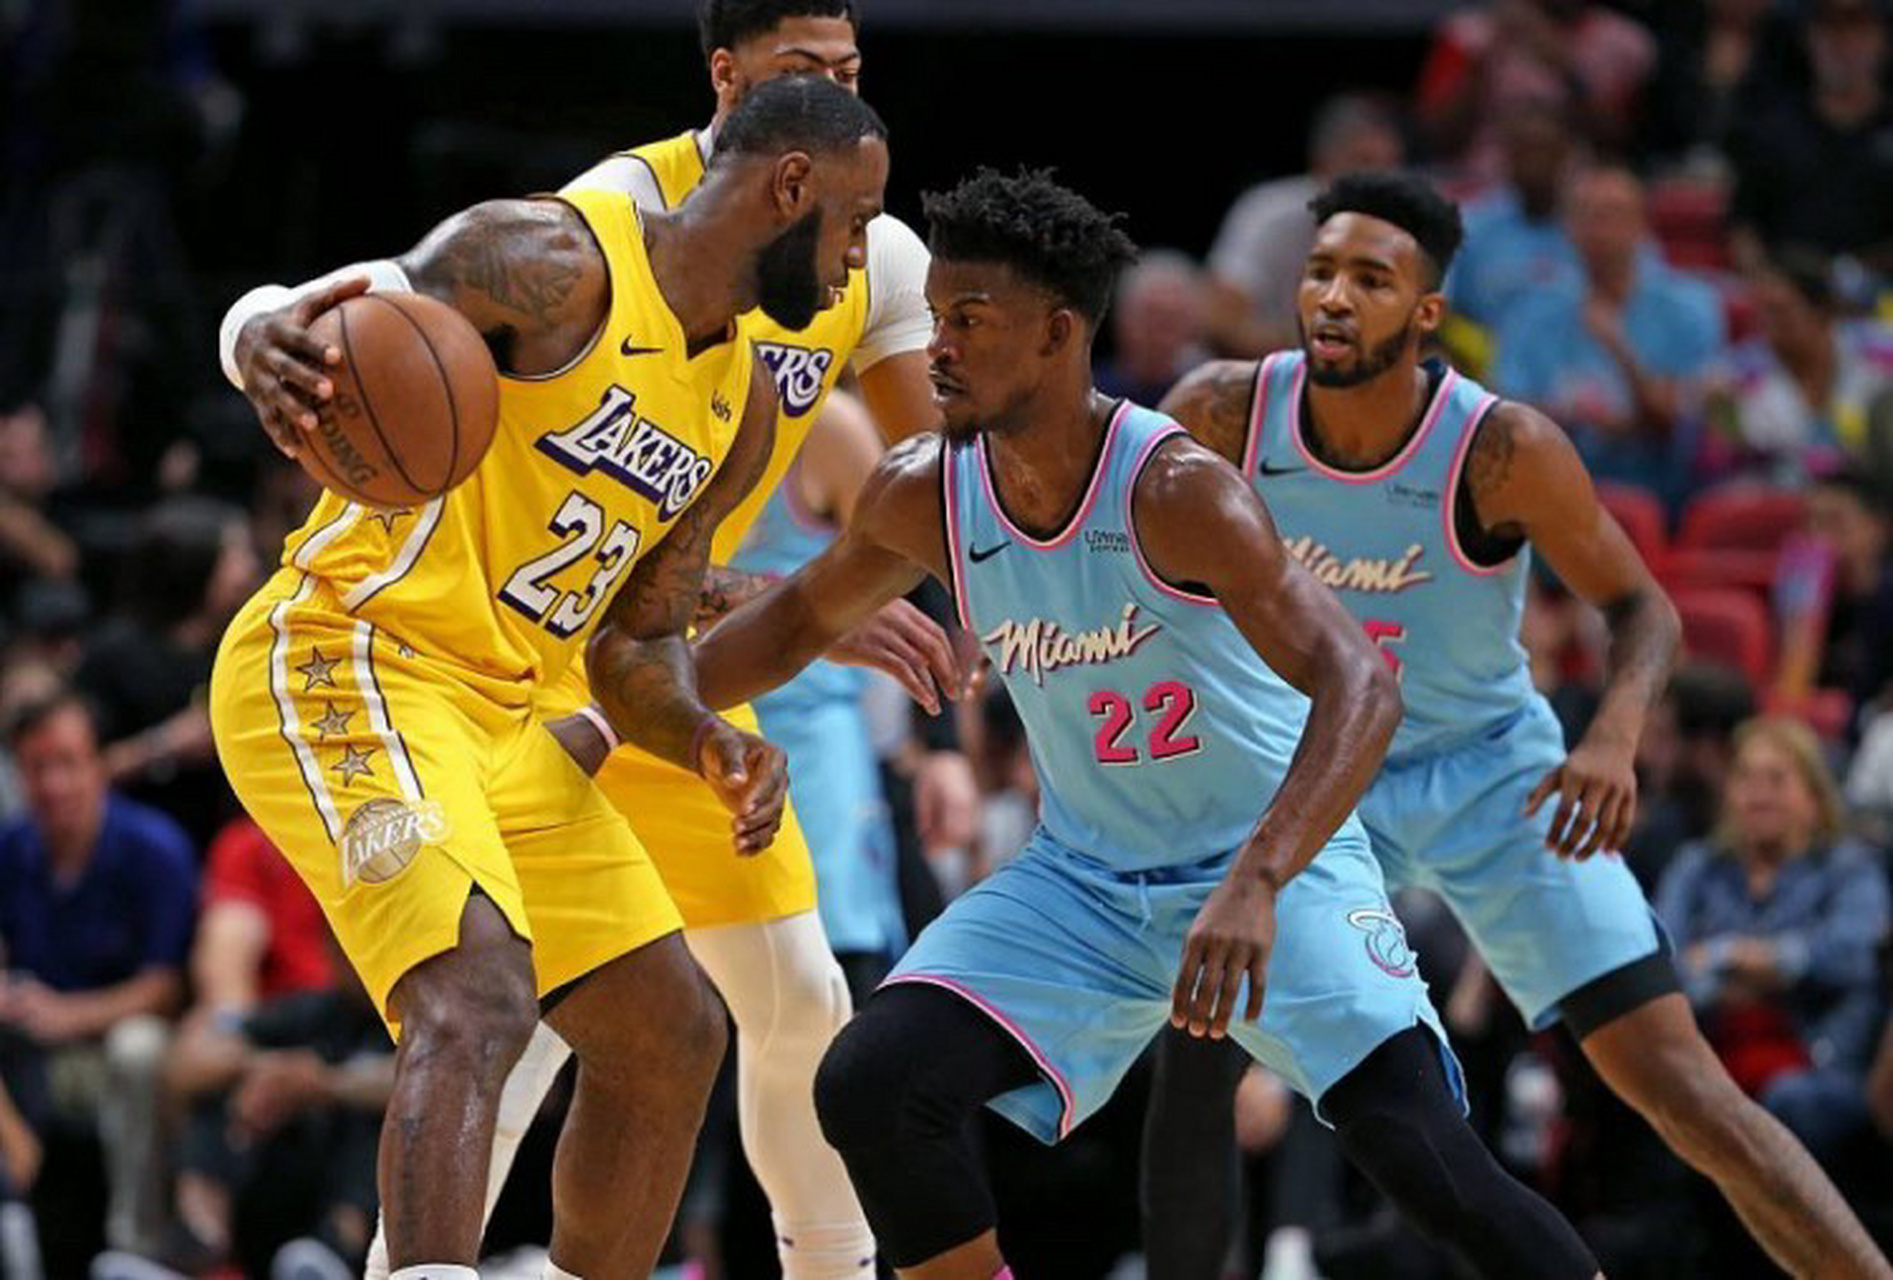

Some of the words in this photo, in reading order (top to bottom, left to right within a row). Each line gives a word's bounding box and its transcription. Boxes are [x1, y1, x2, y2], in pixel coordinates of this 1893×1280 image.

[534, 383, 713, 523] LAKERS
[498, 489, 641, 641] 23
[982, 603, 1163, 687] Miami
[1090, 681, 1201, 767] 22
